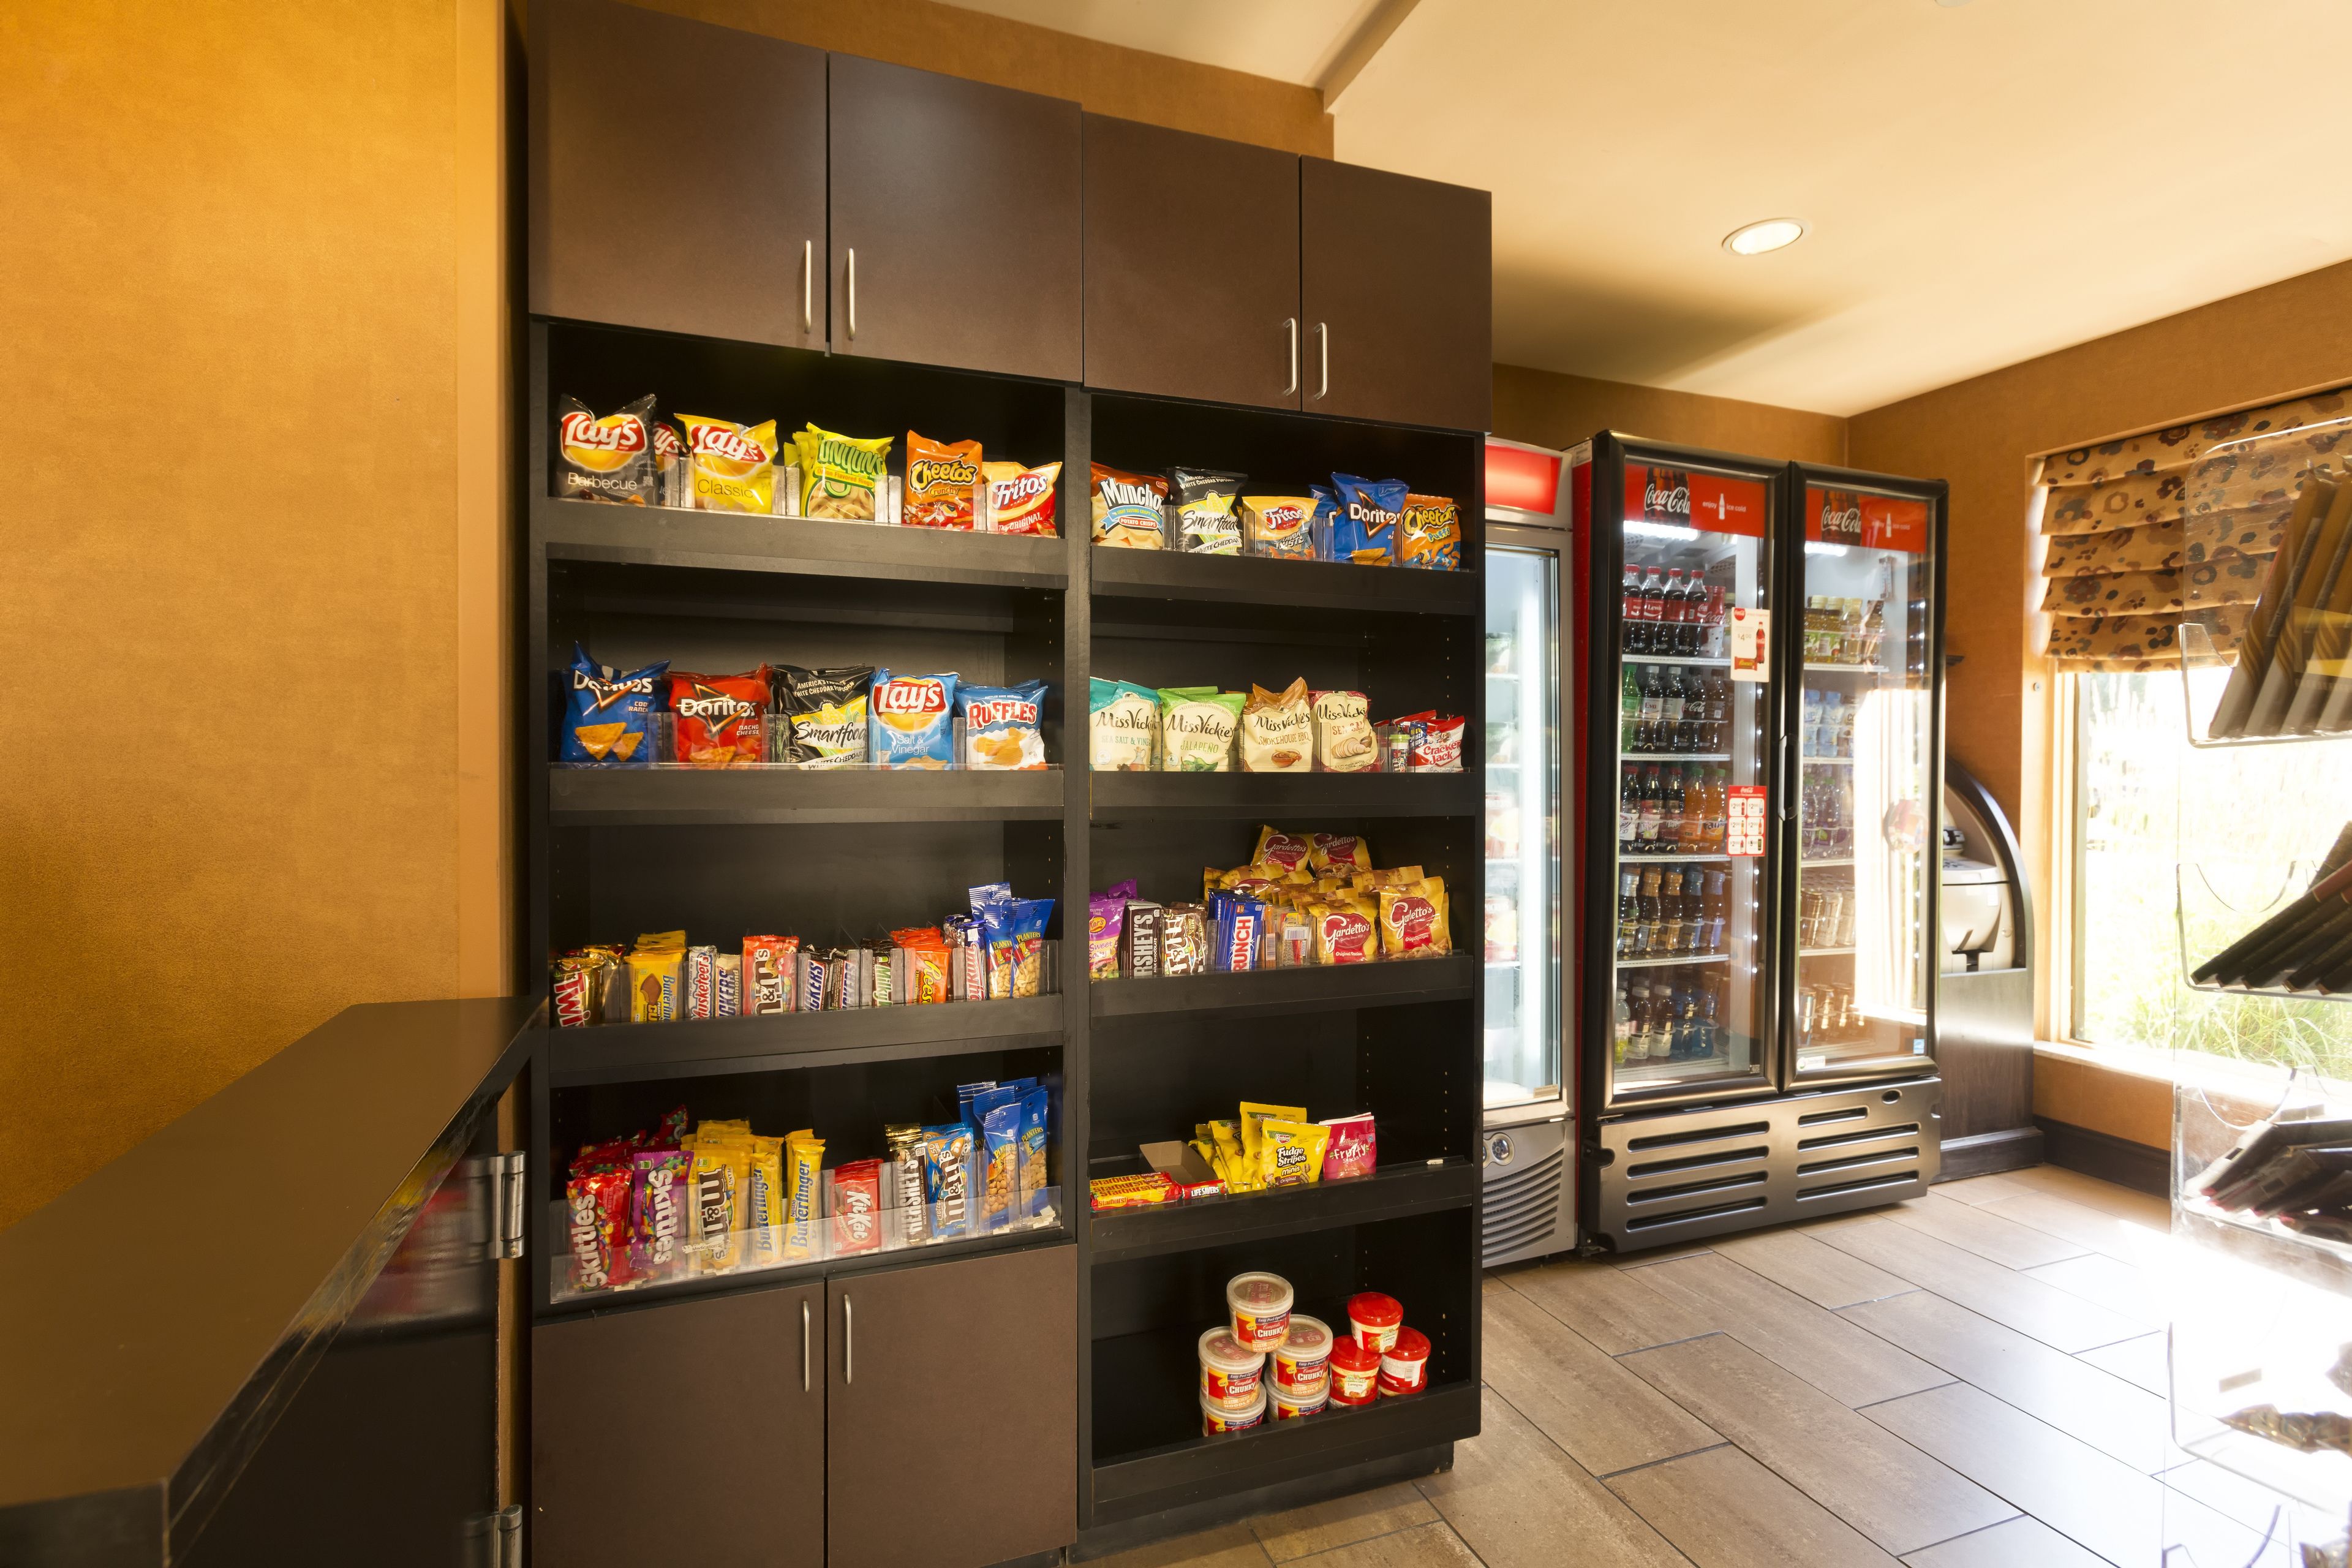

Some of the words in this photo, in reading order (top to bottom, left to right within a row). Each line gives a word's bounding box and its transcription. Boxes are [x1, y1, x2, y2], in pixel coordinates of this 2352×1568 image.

[565, 413, 638, 451] Lay's
[693, 426, 760, 461] Lay's
[568, 472, 638, 491] Barbecue
[834, 472, 857, 483] Flavored
[910, 460, 976, 491] Cheetos
[698, 478, 754, 499] Classic
[929, 486, 960, 497] Crunchy
[992, 475, 1047, 510] Fritos
[1180, 481, 1197, 489] WHITE
[1645, 483, 1691, 514] Coca-Cola
[1009, 512, 1042, 530] ORIGINAL
[1181, 510, 1237, 533] Smartfood
[1263, 508, 1304, 530] Fritos
[1403, 505, 1456, 535] Cheetos
[1213, 538, 1240, 548] CHEDDAR
[797, 679, 826, 690] AMERICA'S
[809, 685, 834, 695] CHEDDAR
[834, 681, 855, 693] POPCORN
[878, 683, 941, 714] Lay's
[968, 702, 1037, 729] RUFFLES
[1096, 711, 1129, 729] Miss
[1316, 704, 1342, 720] Miss
[1166, 714, 1199, 733] Miss
[1196, 714, 1234, 743] Vickie's
[1254, 715, 1281, 732] Miss
[794, 720, 867, 748] Smartfood
[897, 735, 915, 744] Salt
[917, 735, 924, 744] &
[1259, 733, 1297, 746] SMOKEHOUSE
[1298, 732, 1312, 742] BBQ
[891, 744, 930, 755] Vinegar
[1180, 740, 1219, 754] JALAPEÑO
[1423, 741, 1461, 755] Cracker
[834, 751, 863, 763] CHEDDAR
[1428, 749, 1454, 765] Jack
[1262, 834, 1307, 862] Gardetto's
[1313, 832, 1355, 856] Gardetto's
[1016, 931, 1041, 943] PLANTERS
[1322, 915, 1370, 954] Gardetto's
[1090, 941, 1112, 952] Sweet
[1233, 918, 1252, 971] RUNCH
[692, 954, 710, 1020] Musketeers
[1021, 1126, 1044, 1142] PLANTERS
[1277, 1147, 1304, 1158] Fudge
[1278, 1155, 1306, 1166] Stripes
[1281, 1165, 1300, 1176] minis
[1090, 1175, 1140, 1186] Starburst
[1093, 1180, 1145, 1193] Starburst
[904, 1159, 924, 1235] HERSHEY'S
[1099, 1185, 1149, 1197] Starburst
[753, 1166, 773, 1253] Butterfinger
[790, 1159, 815, 1248] Butterfinger
[1098, 1197, 1127, 1207] Starburst
[648, 1168, 678, 1265] Skittles
[571, 1194, 608, 1289] Skittles
[1257, 1325, 1284, 1338] CHUNKY
[1297, 1368, 1324, 1381] CHUNKY
[1229, 1382, 1256, 1394] CHUNKY
